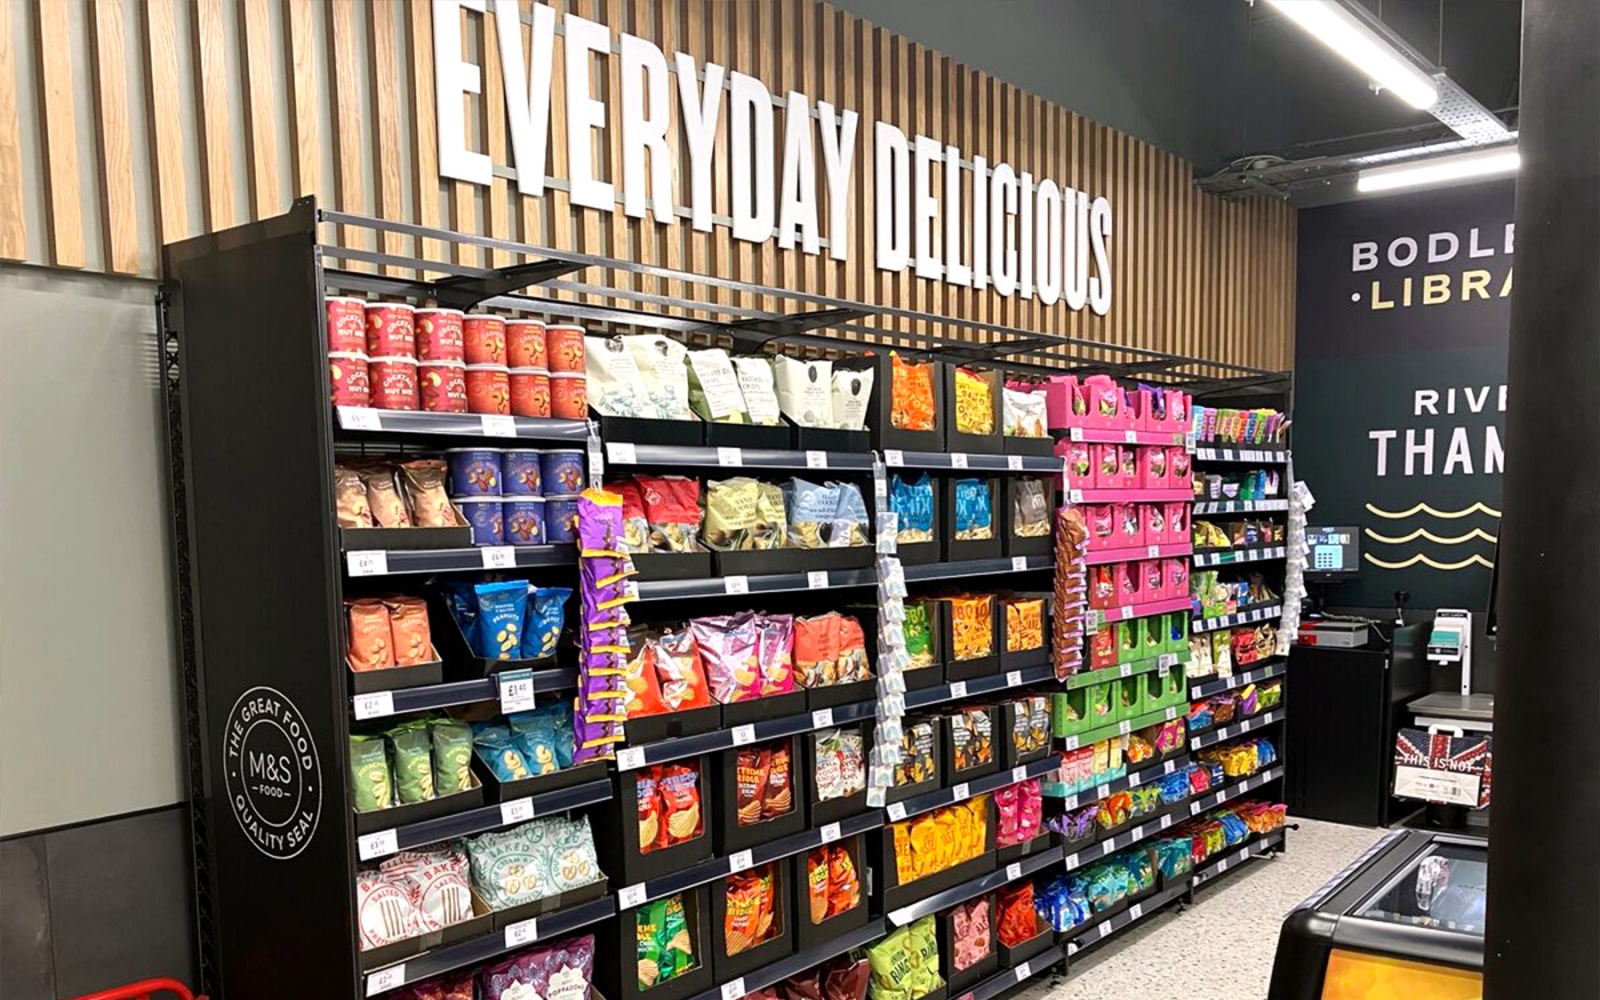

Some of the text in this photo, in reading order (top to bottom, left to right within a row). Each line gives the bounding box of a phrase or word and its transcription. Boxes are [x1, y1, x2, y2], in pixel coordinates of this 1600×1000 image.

[432, 0, 1112, 316] EVERYDAY DELICIOUS
[492, 613, 520, 624] PEANUTS
[229, 698, 313, 770] THE GREAT FOOD
[249, 750, 291, 784] M&S
[1403, 754, 1473, 772] THIS IS NOT
[259, 784, 284, 798] FOOD
[236, 794, 314, 851] QUALITY SEAL
[488, 841, 530, 859] BAKED
[371, 888, 400, 904] SALTED
